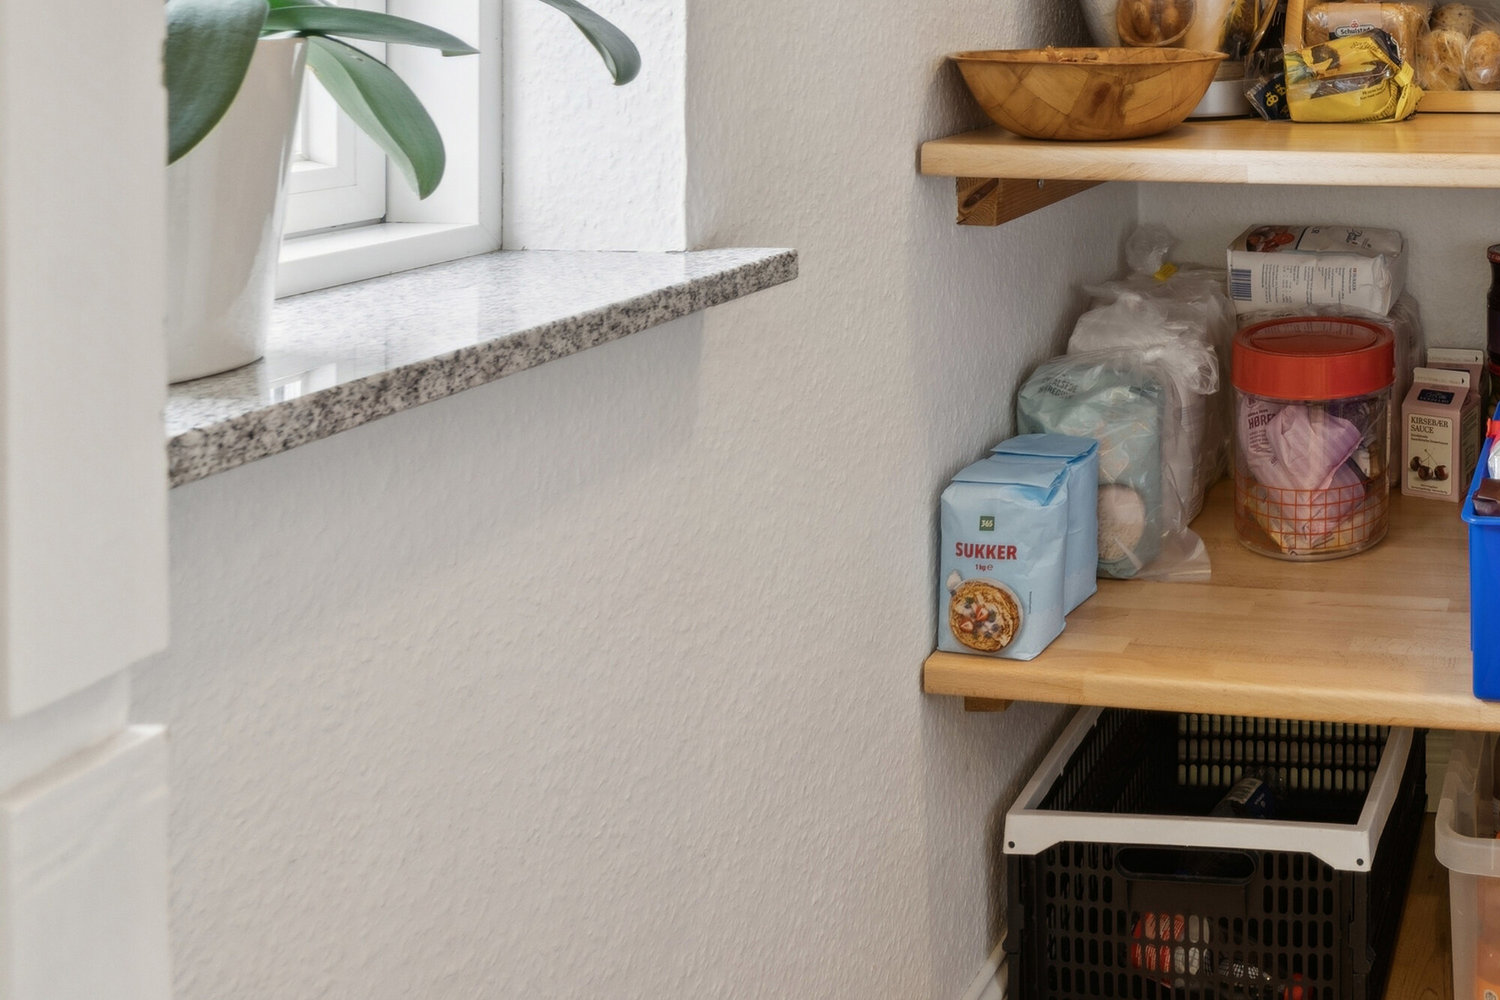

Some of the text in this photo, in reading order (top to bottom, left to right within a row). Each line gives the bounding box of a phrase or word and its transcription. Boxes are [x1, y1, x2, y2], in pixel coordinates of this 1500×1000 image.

[1411, 416, 1449, 428] KIRSEBÆR
[1411, 425, 1434, 434] SAUCE
[981, 519, 993, 528] 365
[955, 542, 1017, 560] SUKKER
